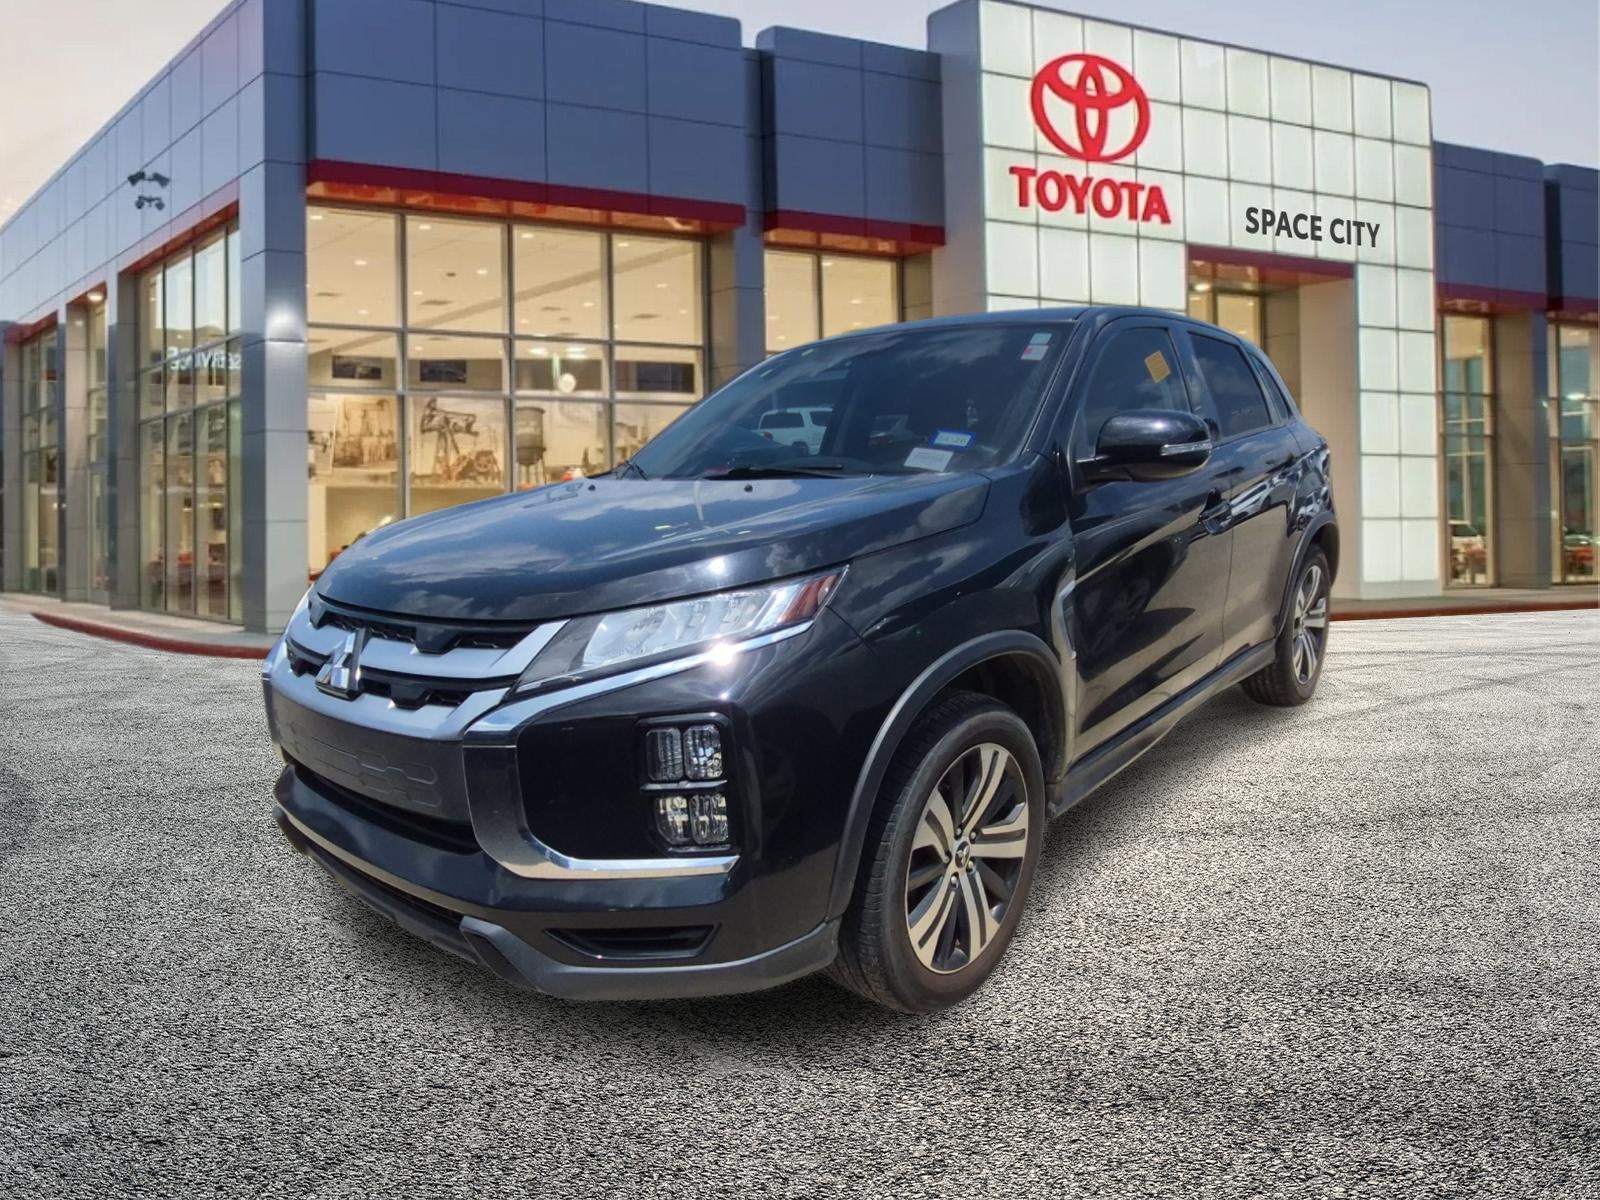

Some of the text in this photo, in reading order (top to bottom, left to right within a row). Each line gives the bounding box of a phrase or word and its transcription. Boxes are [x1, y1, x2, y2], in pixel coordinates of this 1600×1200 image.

[1009, 166, 1171, 224] TOYOTA
[1245, 206, 1380, 248] SPACE CITY
